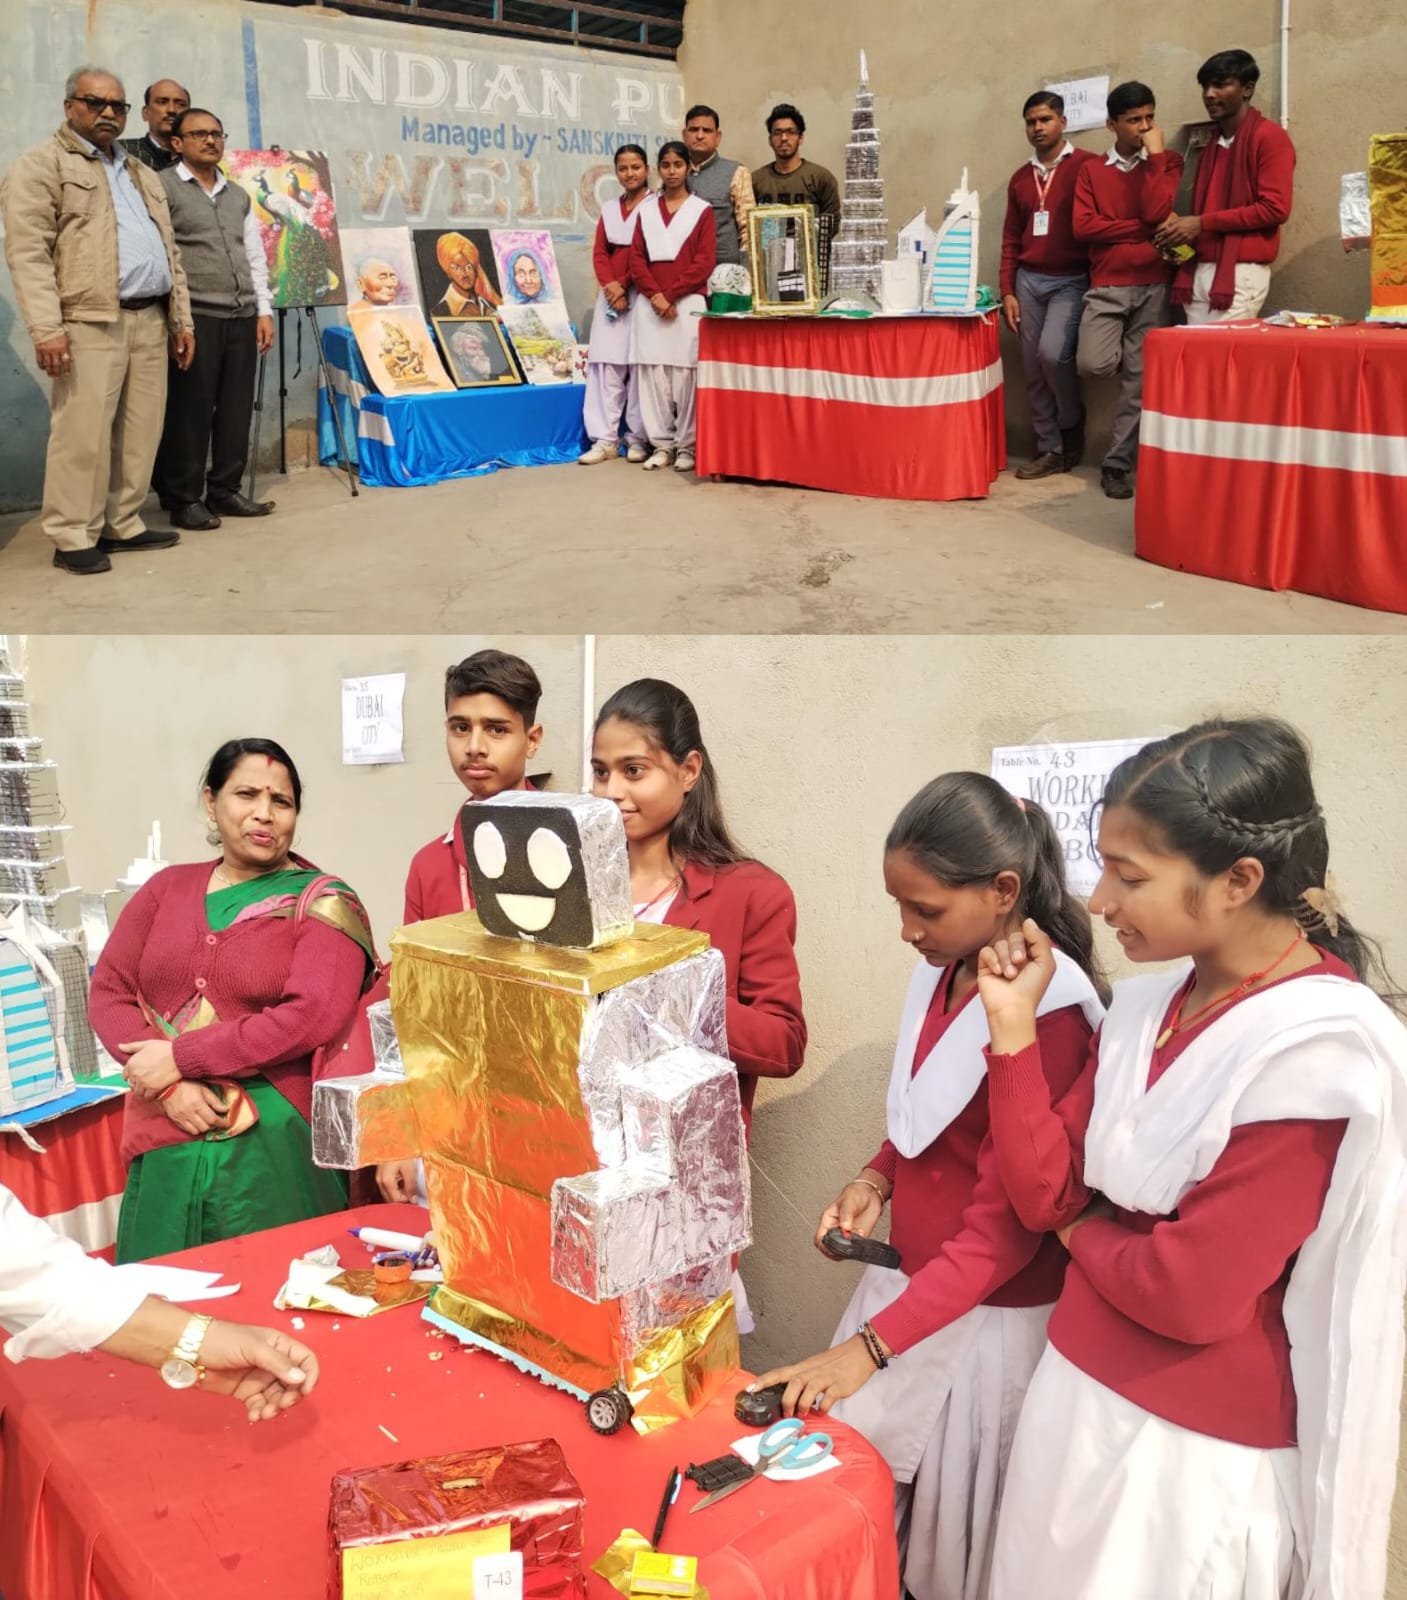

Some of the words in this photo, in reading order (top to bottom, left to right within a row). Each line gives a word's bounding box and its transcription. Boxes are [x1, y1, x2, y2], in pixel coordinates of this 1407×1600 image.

[303, 38, 583, 120] INDIAN
[402, 115, 505, 154] Managed
[355, 694, 384, 719] DUBAI
[1000, 758, 1024, 768] Table
[1050, 750, 1075, 769] 43
[483, 1570, 513, 1590] T-43
